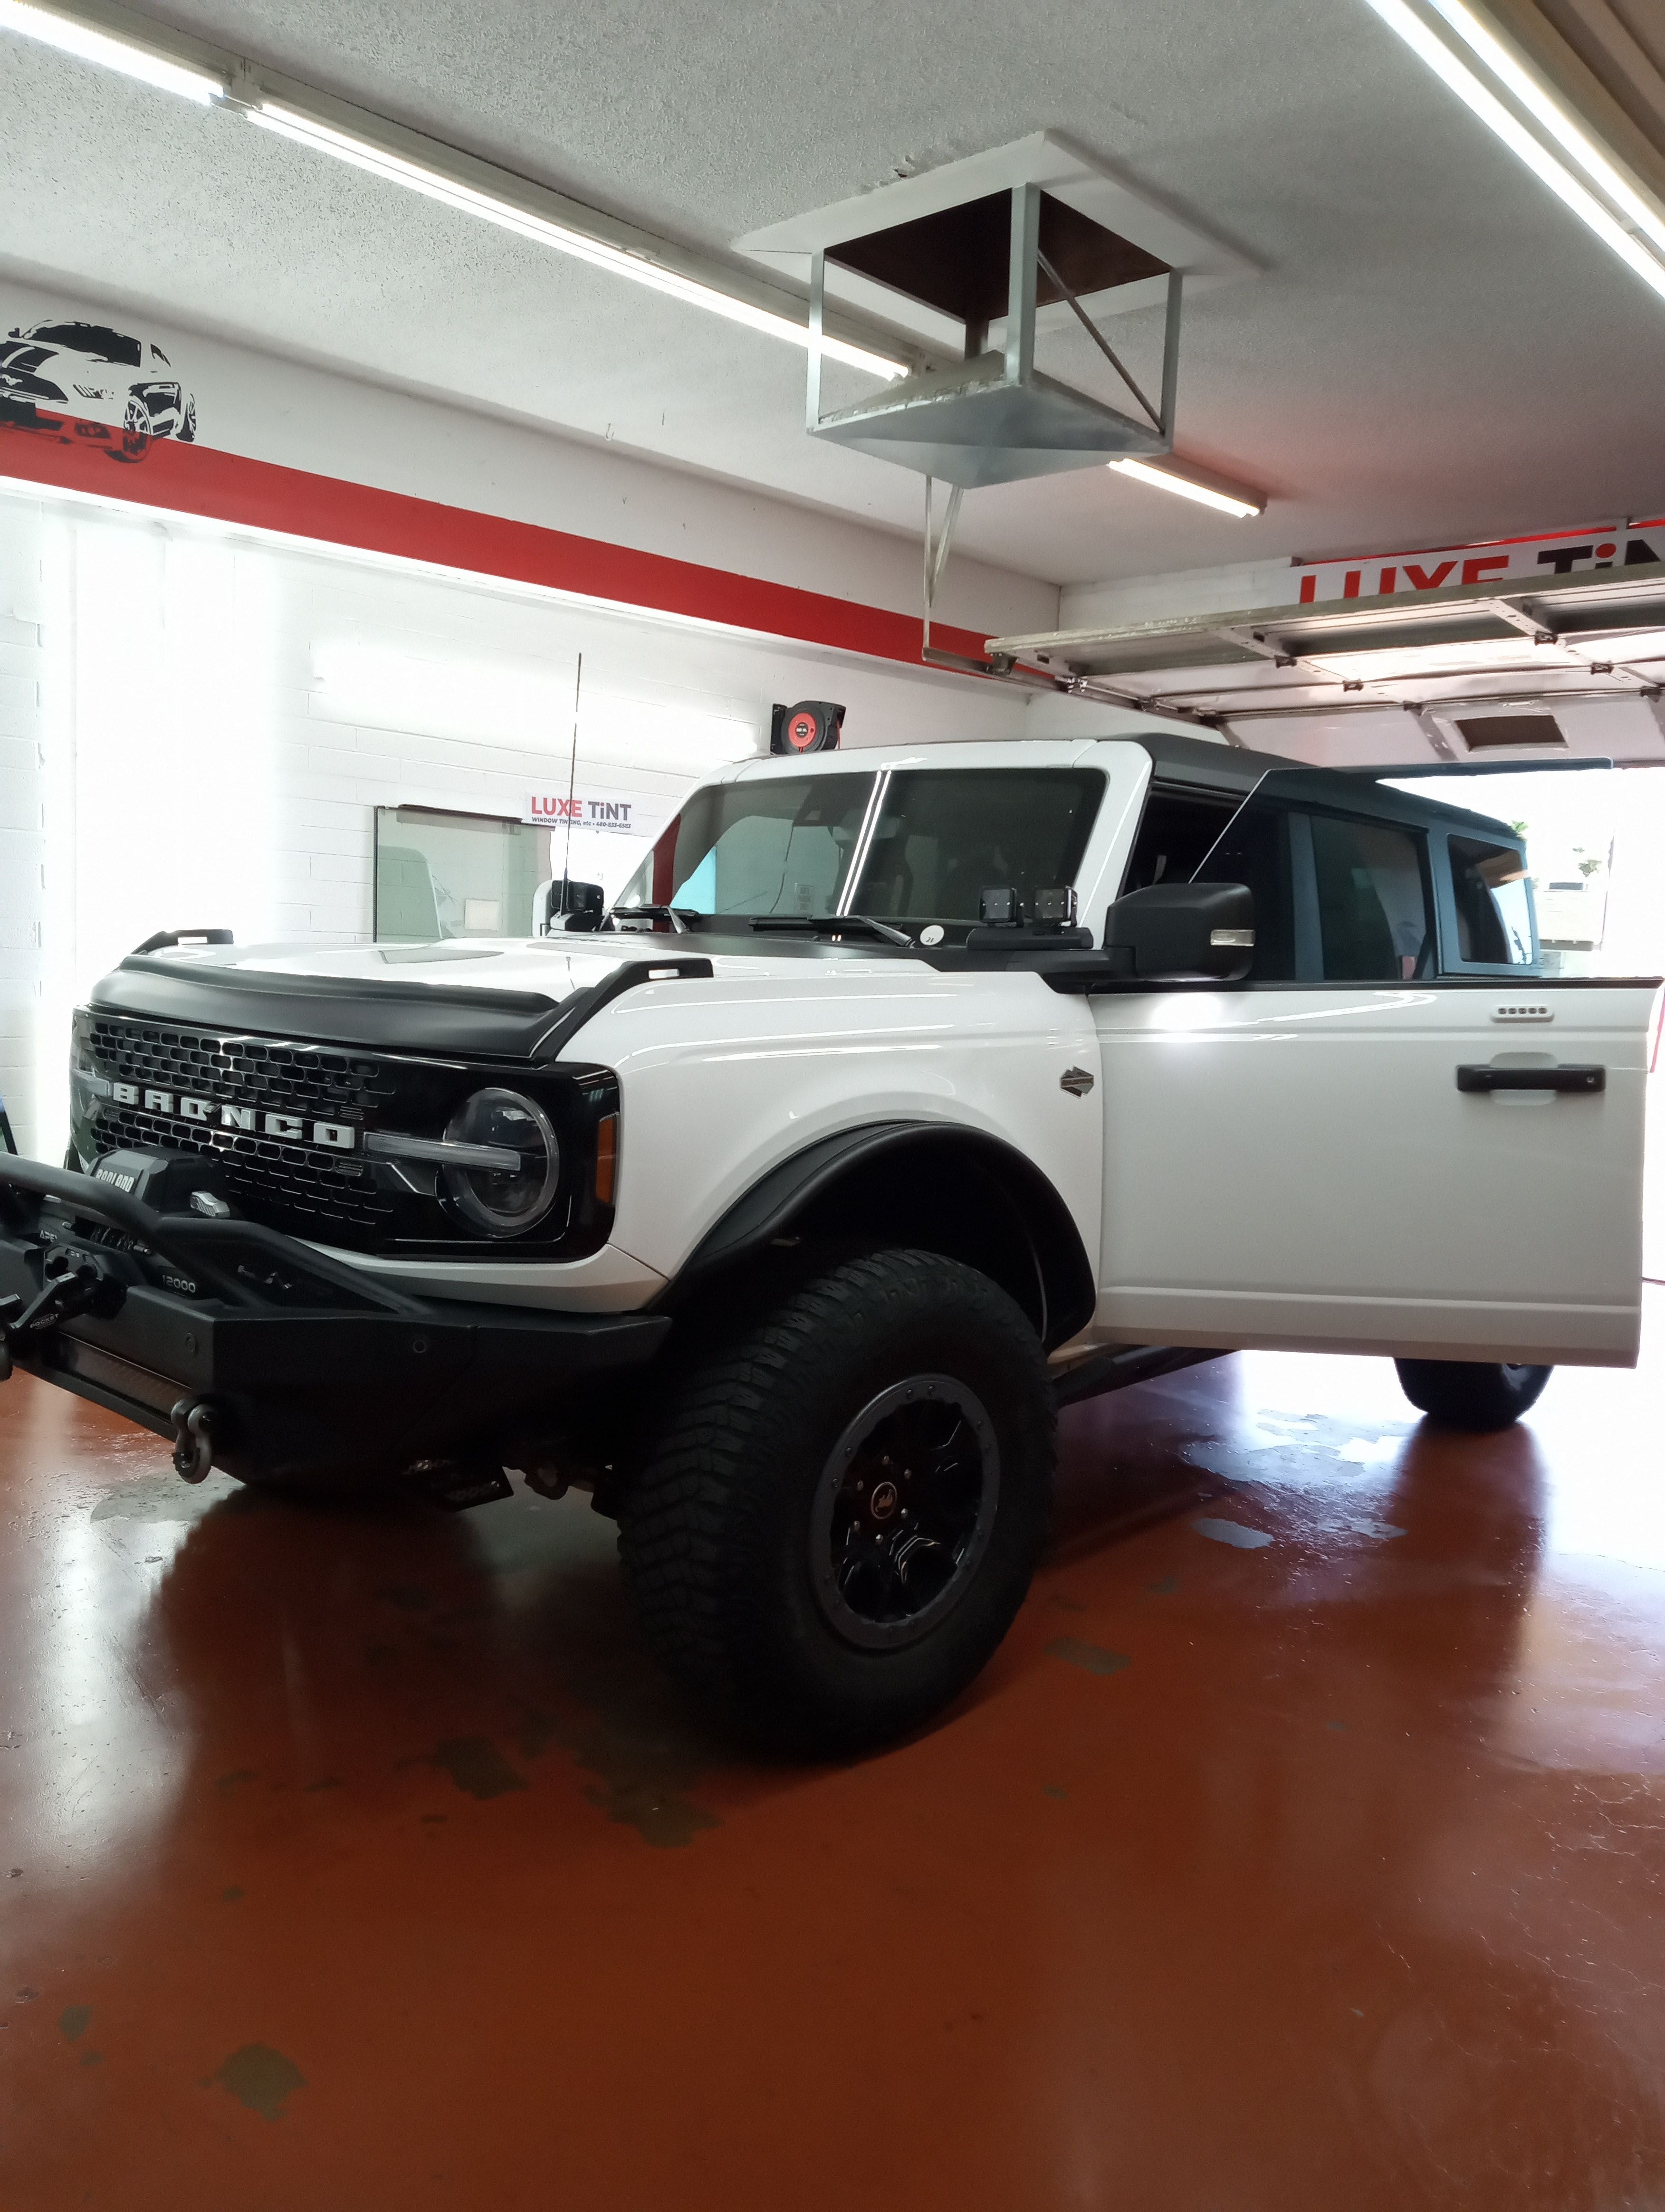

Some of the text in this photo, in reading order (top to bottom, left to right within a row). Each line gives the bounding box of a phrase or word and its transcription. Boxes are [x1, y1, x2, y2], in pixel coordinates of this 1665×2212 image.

[531, 796, 582, 818] LUXE
[113, 1081, 355, 1149] BRONCO
[162, 1274, 196, 1293] 12000
[30, 1313, 59, 1328] POCKET
